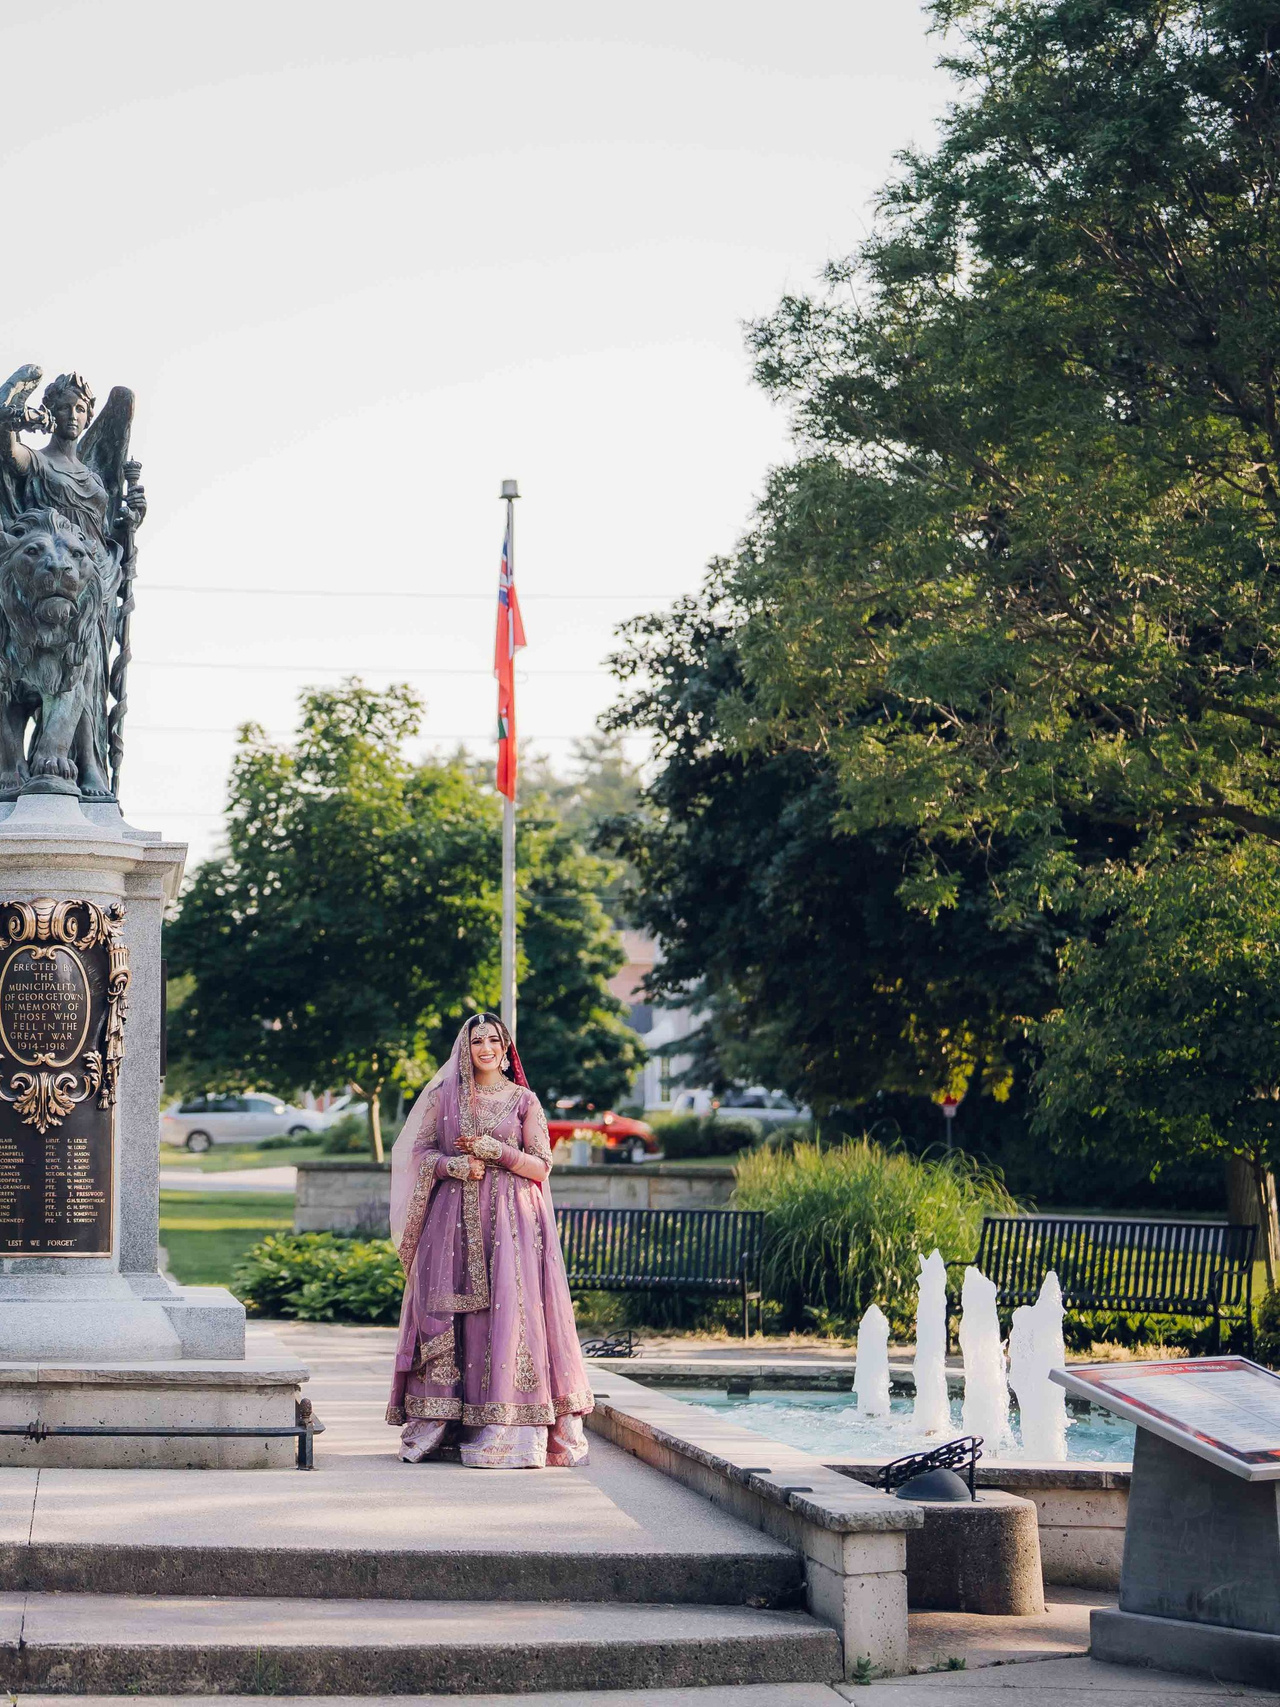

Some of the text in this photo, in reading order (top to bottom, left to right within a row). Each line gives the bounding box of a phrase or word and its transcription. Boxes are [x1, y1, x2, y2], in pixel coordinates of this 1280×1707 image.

[14, 962, 72, 972] ERECTED BY
[9, 983, 76, 991] MUNICIPALITY
[10, 1032, 74, 1040] GREAT WAR.
